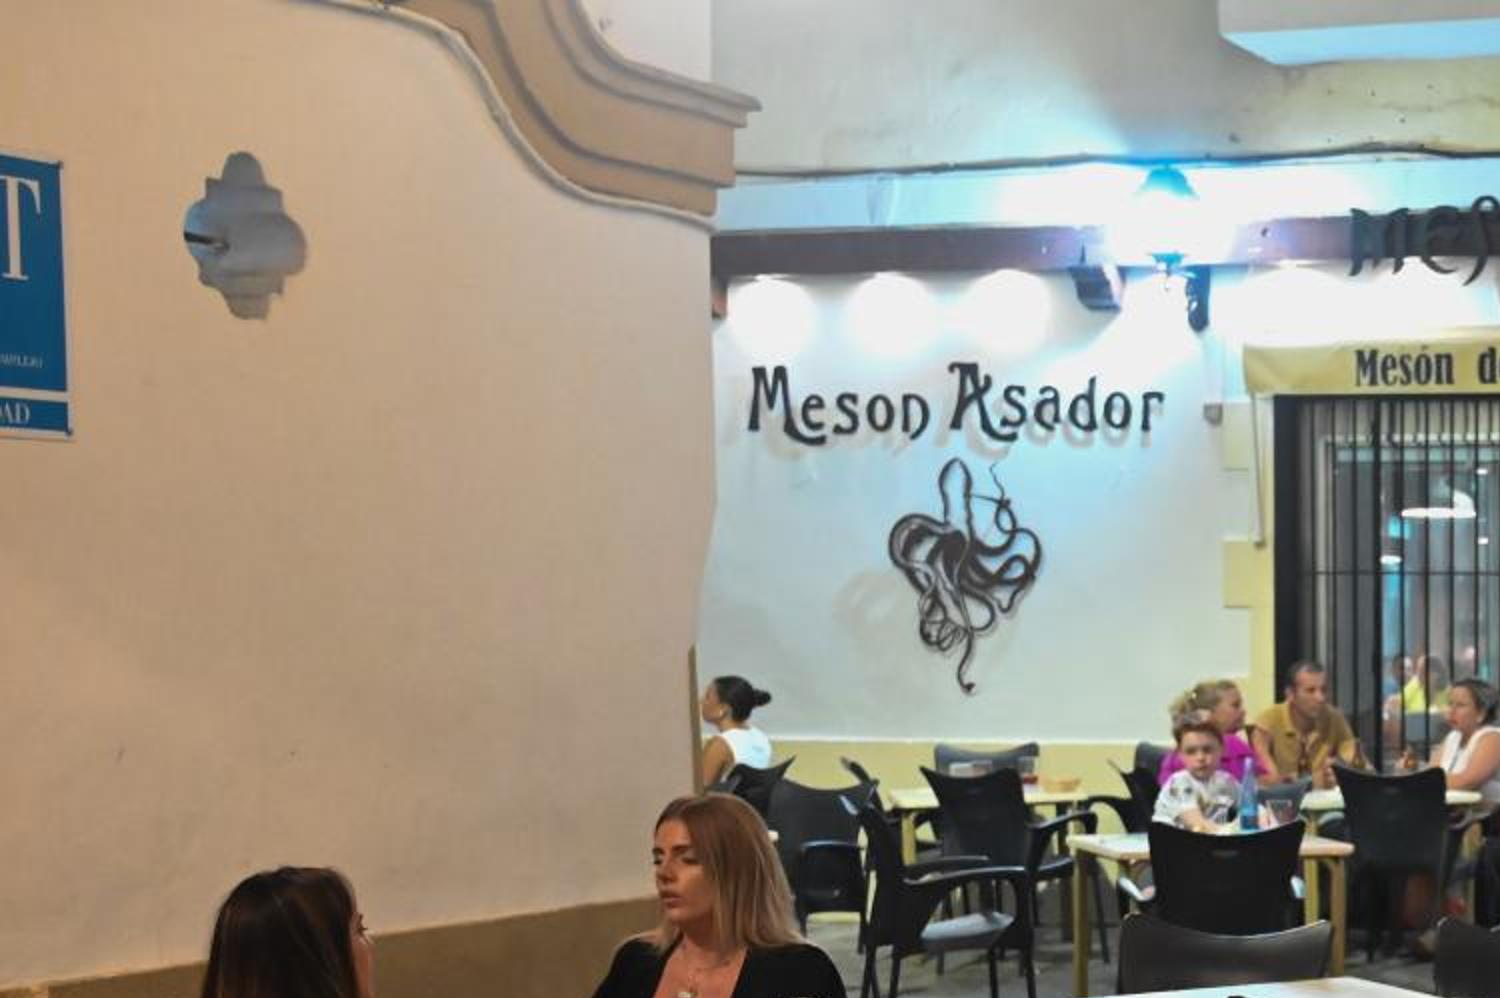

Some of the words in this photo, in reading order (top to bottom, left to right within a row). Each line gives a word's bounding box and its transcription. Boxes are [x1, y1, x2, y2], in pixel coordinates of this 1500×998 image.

[0, 176, 41, 281] T
[1354, 346, 1455, 387] Mesón
[0, 401, 31, 425] AD
[748, 365, 930, 446] Meson
[948, 361, 1165, 442] Asador
